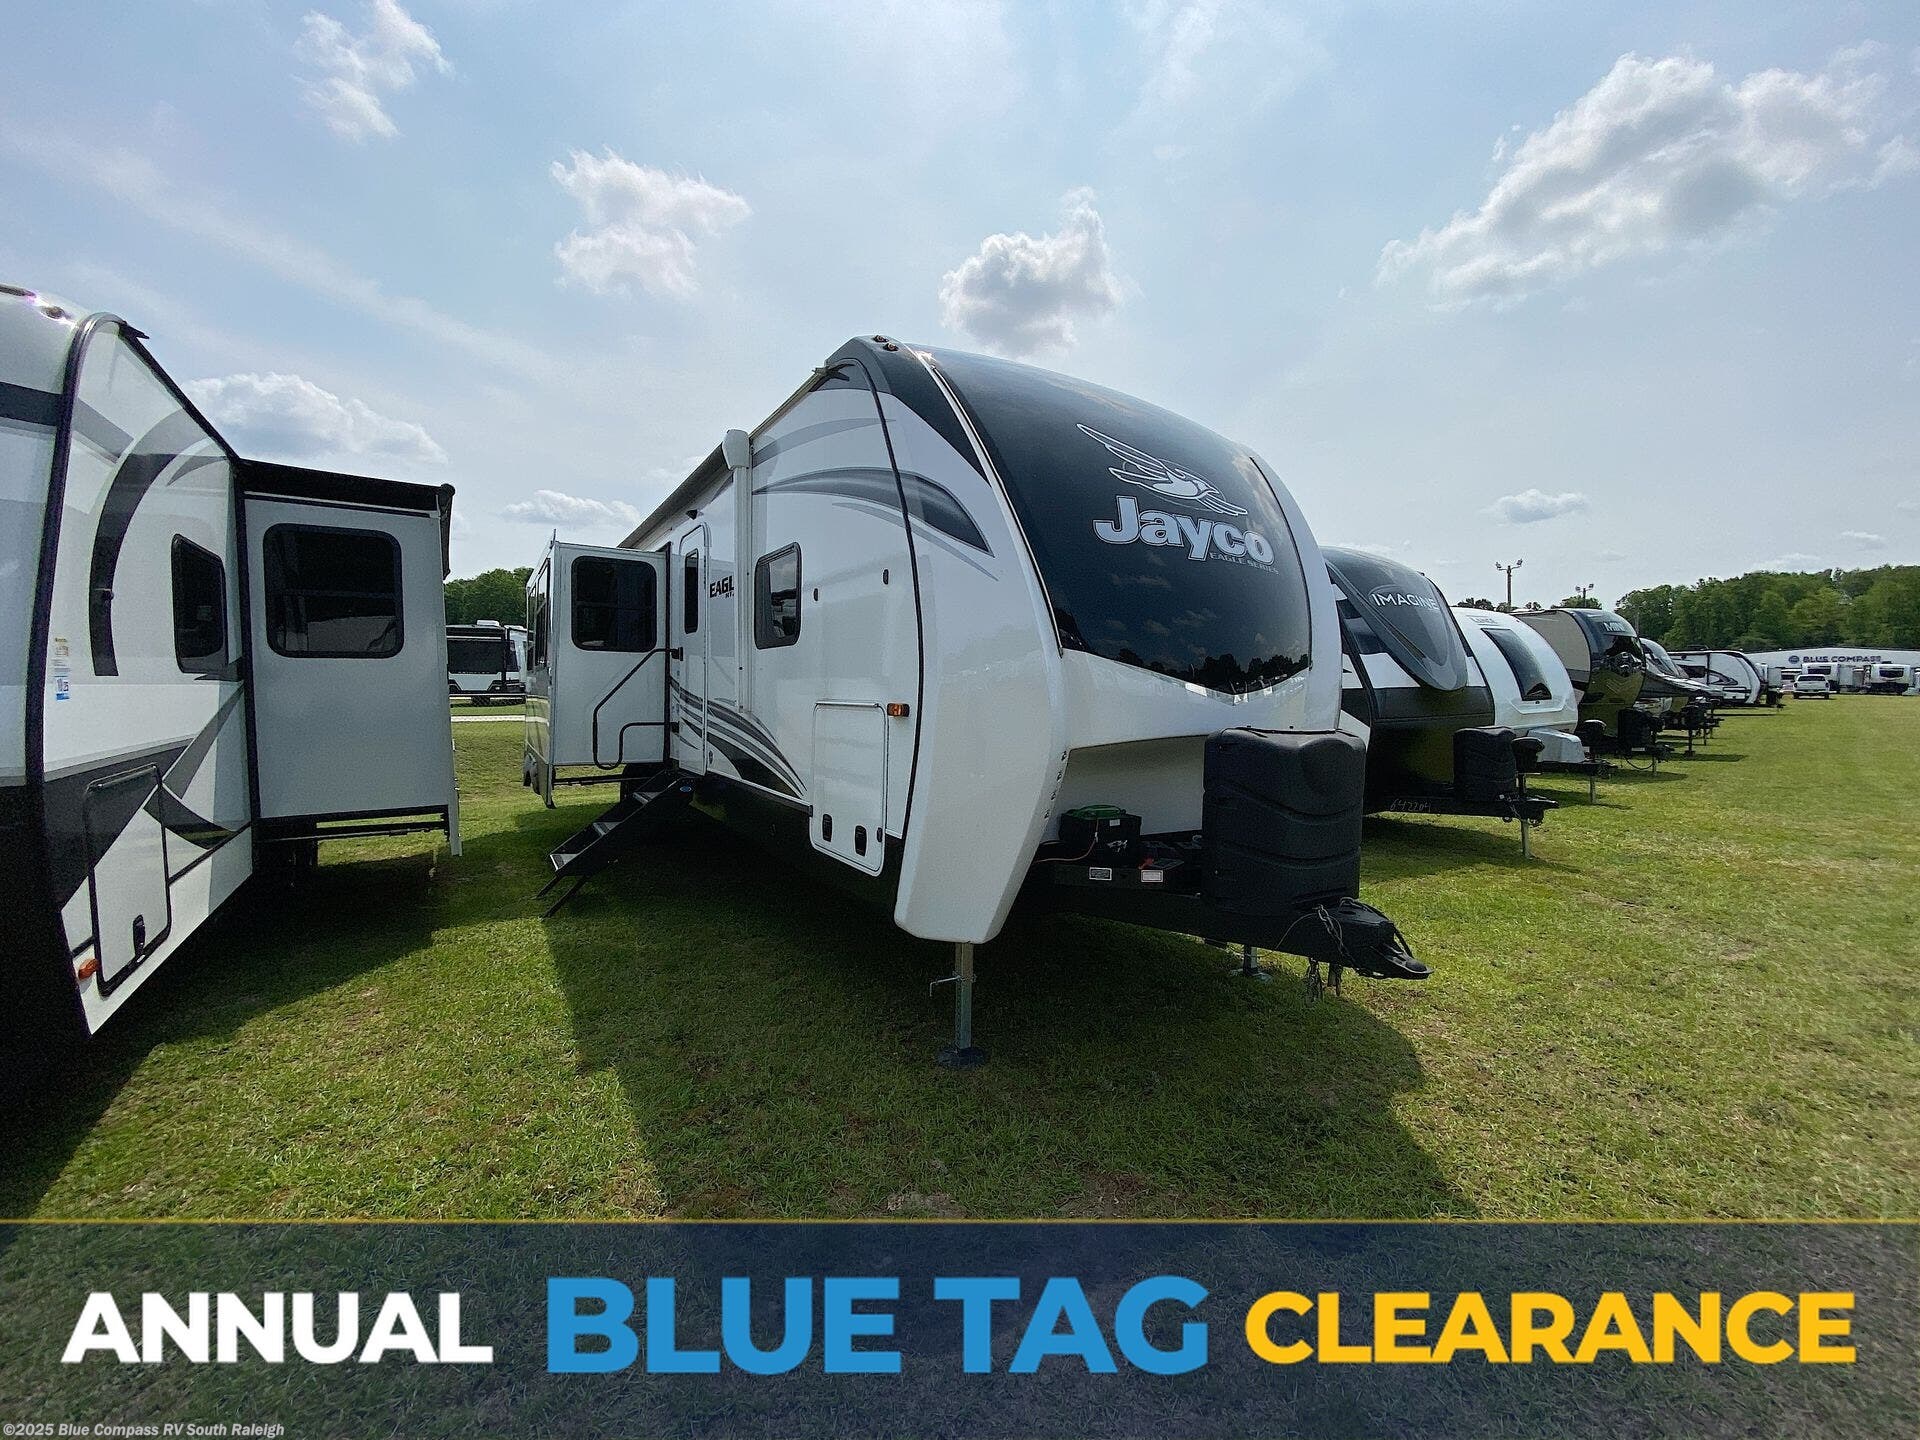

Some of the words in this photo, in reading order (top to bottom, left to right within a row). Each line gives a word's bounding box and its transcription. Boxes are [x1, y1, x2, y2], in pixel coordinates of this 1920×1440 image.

[1093, 495, 1275, 566] Jayco
[709, 575, 735, 599] EAGL
[1371, 593, 1440, 610] IMAGINE
[1830, 655, 1882, 663] COMPASS
